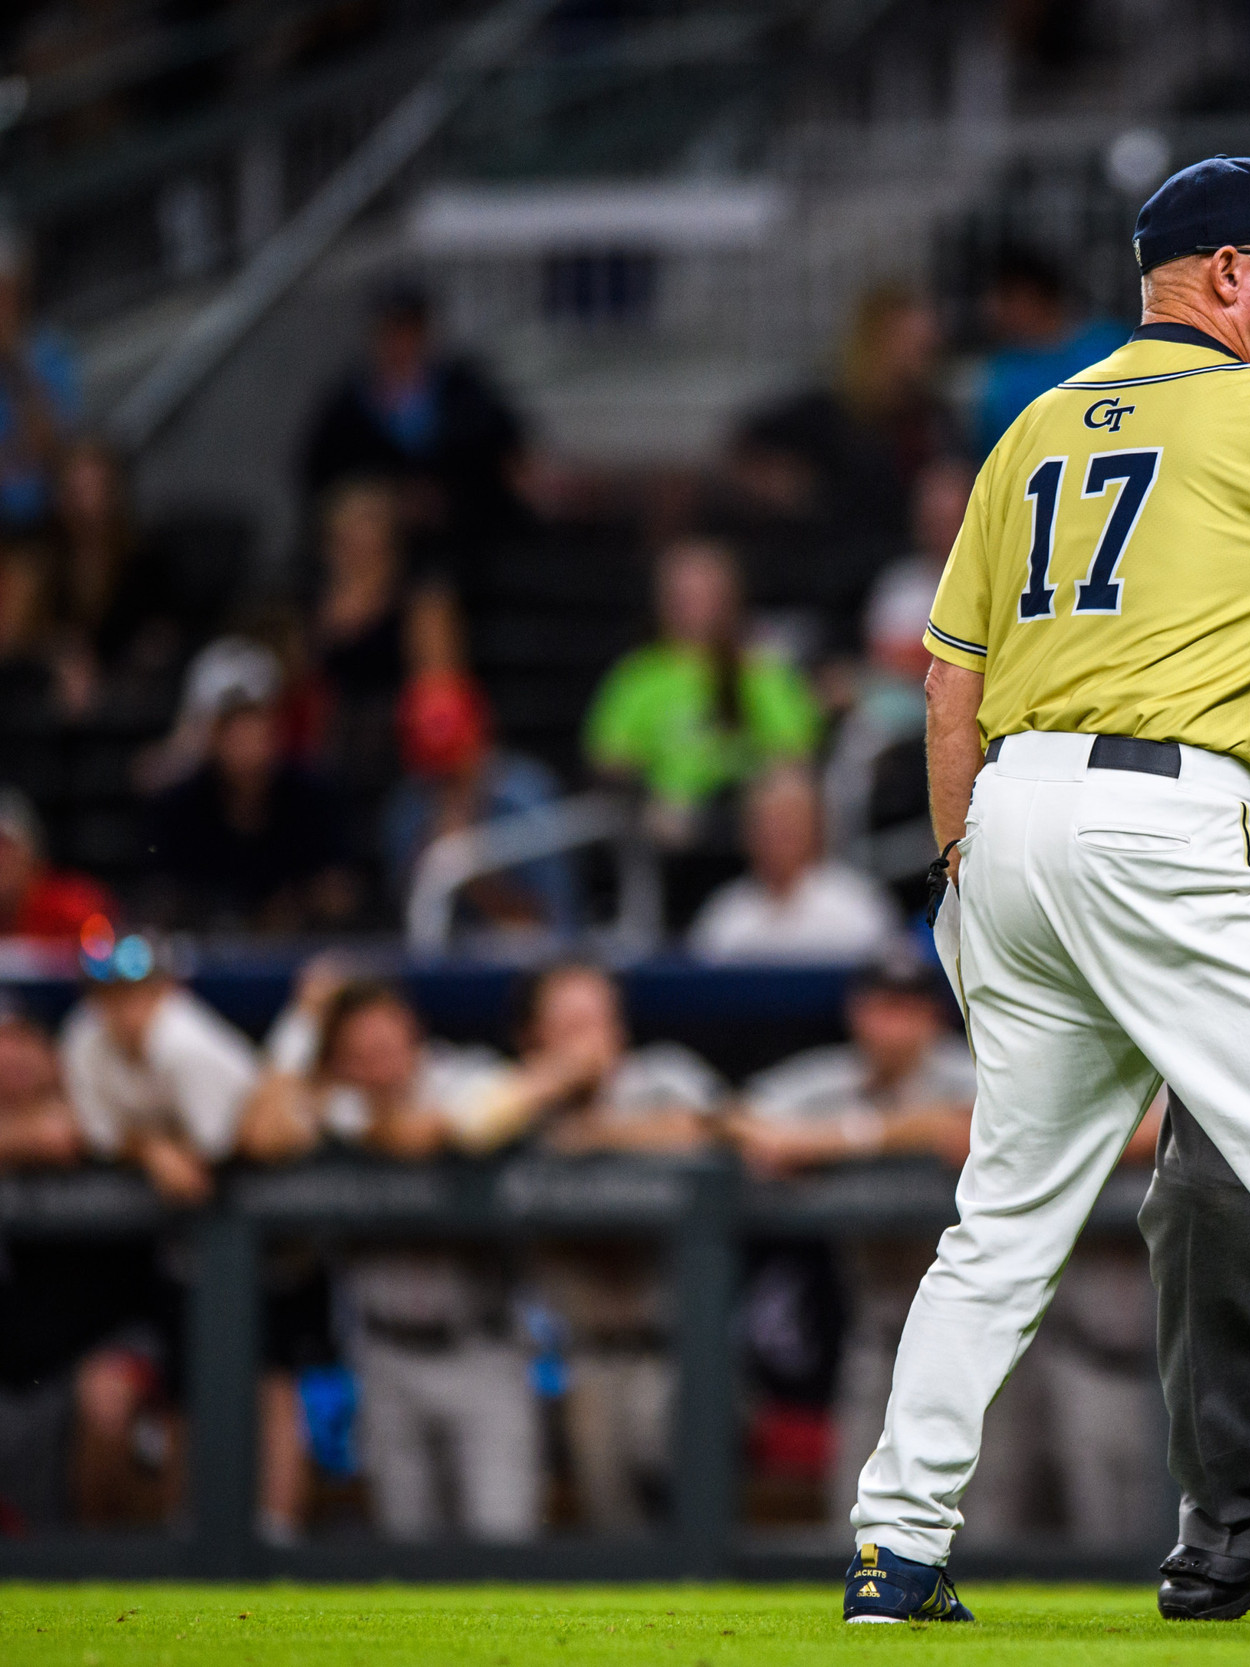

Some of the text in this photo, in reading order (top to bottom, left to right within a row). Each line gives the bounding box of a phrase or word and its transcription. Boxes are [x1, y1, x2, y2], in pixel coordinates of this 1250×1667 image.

[1083, 396, 1137, 433] GT
[1017, 446, 1164, 624] 17
[854, 1569, 887, 1579] JACKETS
